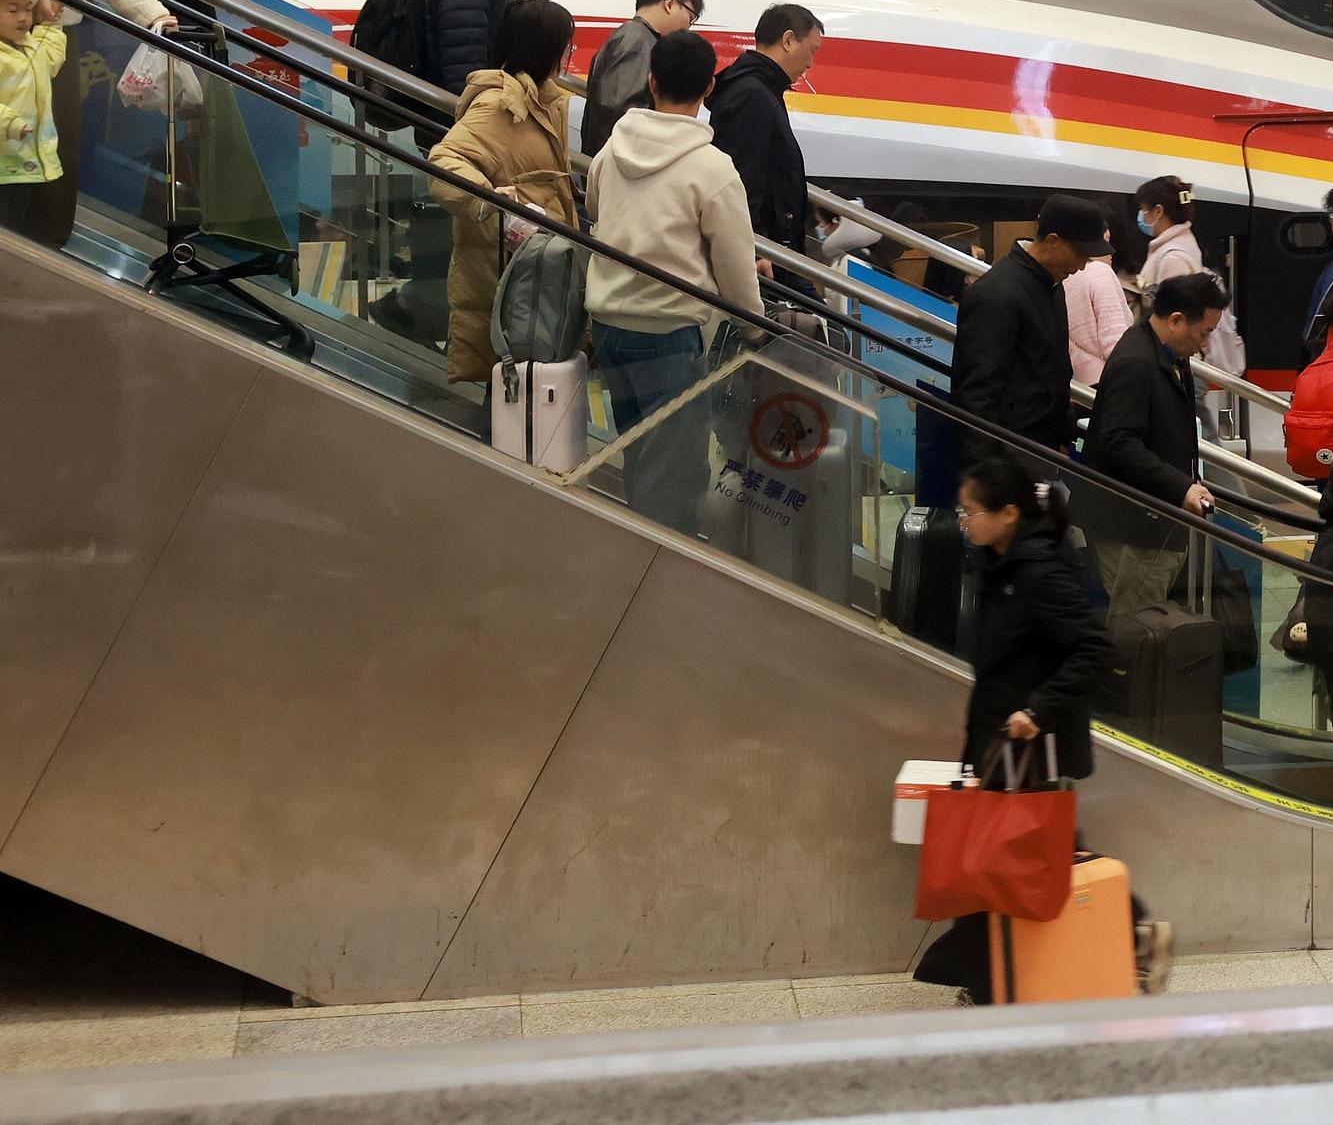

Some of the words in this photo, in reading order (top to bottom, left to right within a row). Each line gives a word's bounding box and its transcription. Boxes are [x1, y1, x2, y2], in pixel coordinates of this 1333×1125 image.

[714, 481, 733, 497] No
[736, 491, 791, 526] Climbing
[720, 459, 807, 512] 严禁攀爬
